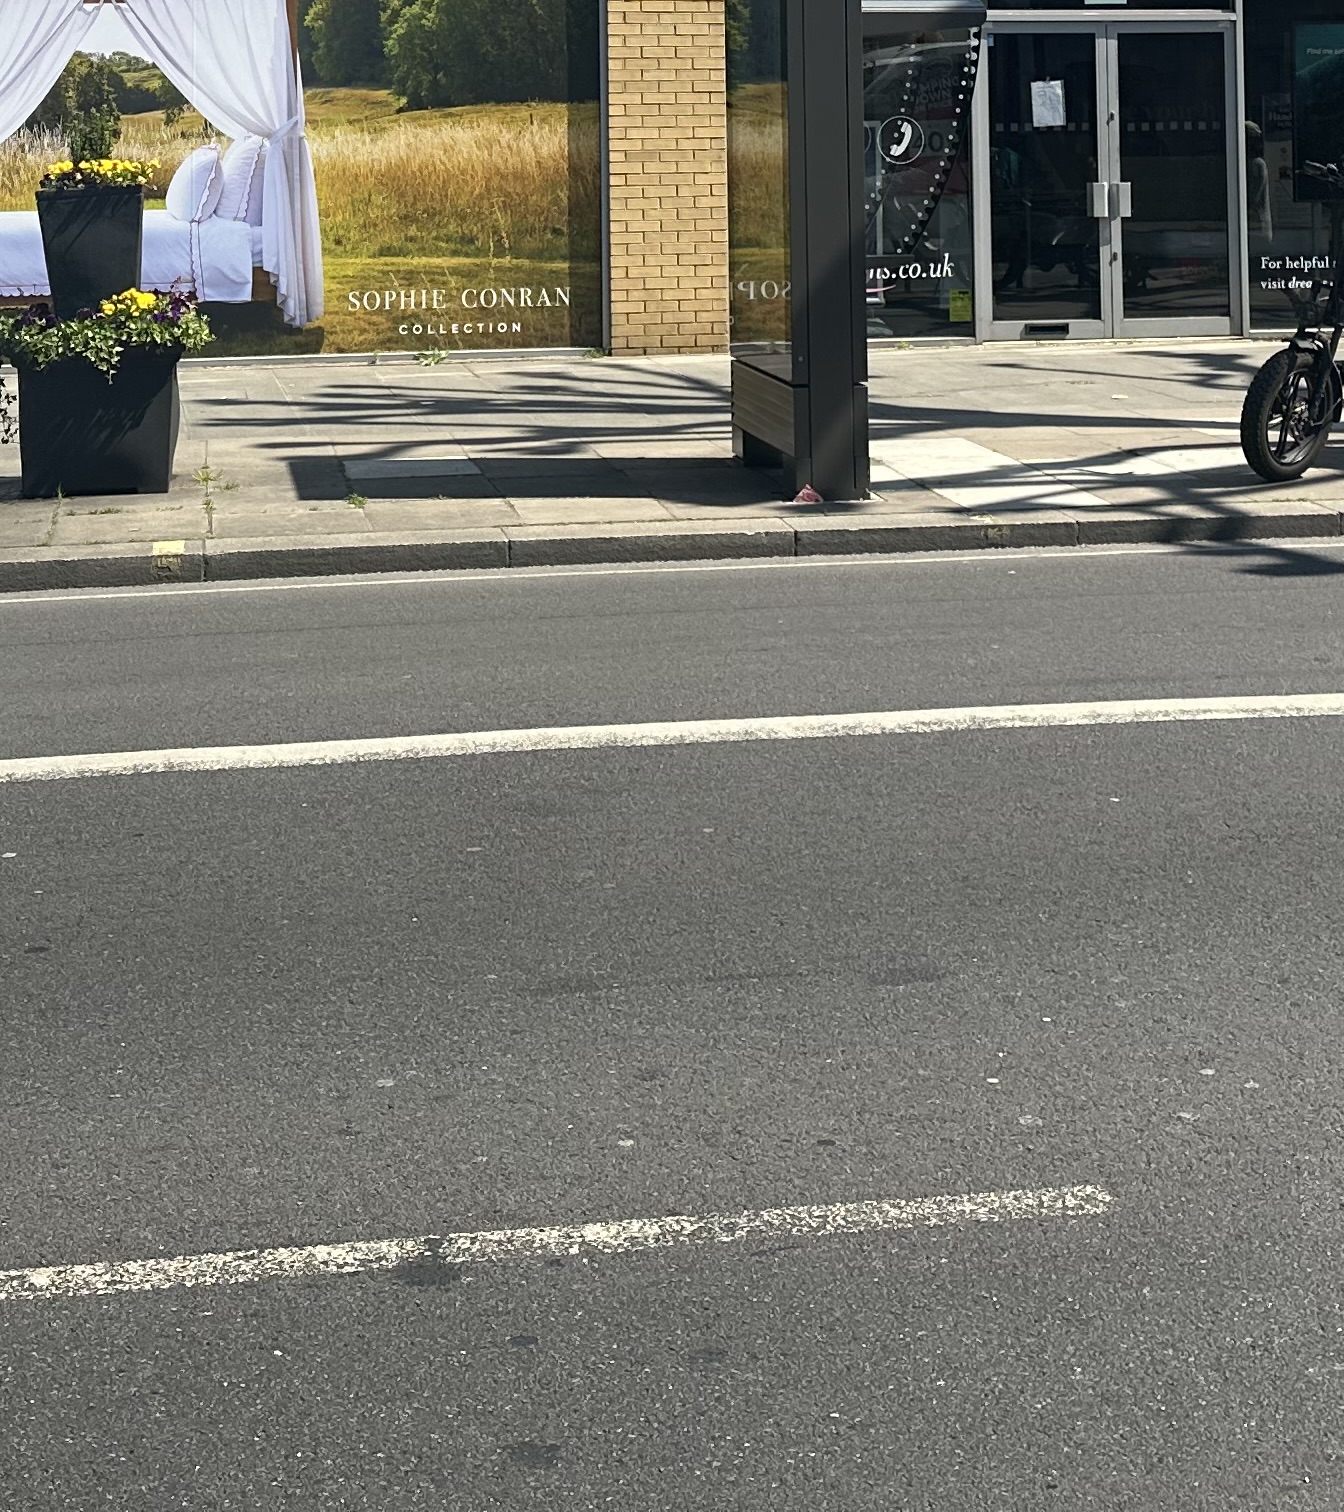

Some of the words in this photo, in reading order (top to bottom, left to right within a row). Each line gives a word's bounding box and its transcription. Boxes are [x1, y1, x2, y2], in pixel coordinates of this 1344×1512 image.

[1260, 256, 1282, 269] For
[1285, 256, 1329, 273] helpful
[1260, 277, 1285, 289] visit
[348, 289, 447, 312] SOPHIE
[461, 286, 570, 309] CONRAN
[398, 322, 521, 335] COLLECTION
